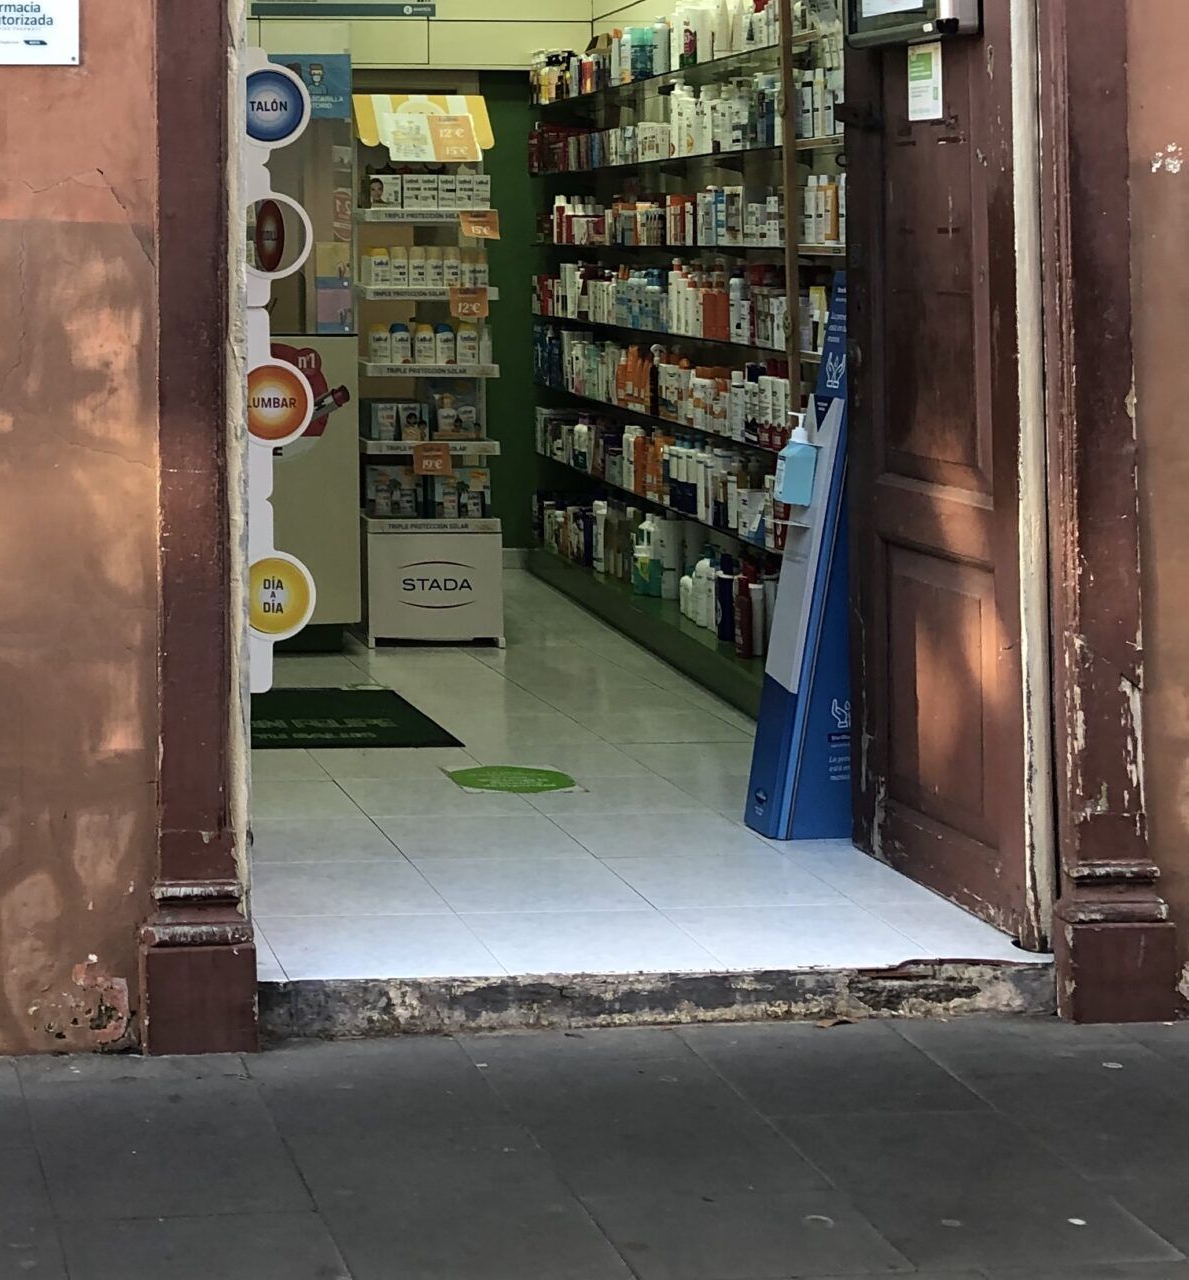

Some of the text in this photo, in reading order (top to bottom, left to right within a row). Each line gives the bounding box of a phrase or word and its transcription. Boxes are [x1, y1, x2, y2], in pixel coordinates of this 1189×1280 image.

[249, 99, 288, 112] TALÓN
[263, 576, 284, 591] DÍA
[402, 578, 473, 591] STADA
[270, 591, 276, 599] A
[263, 599, 284, 614] DÍA
